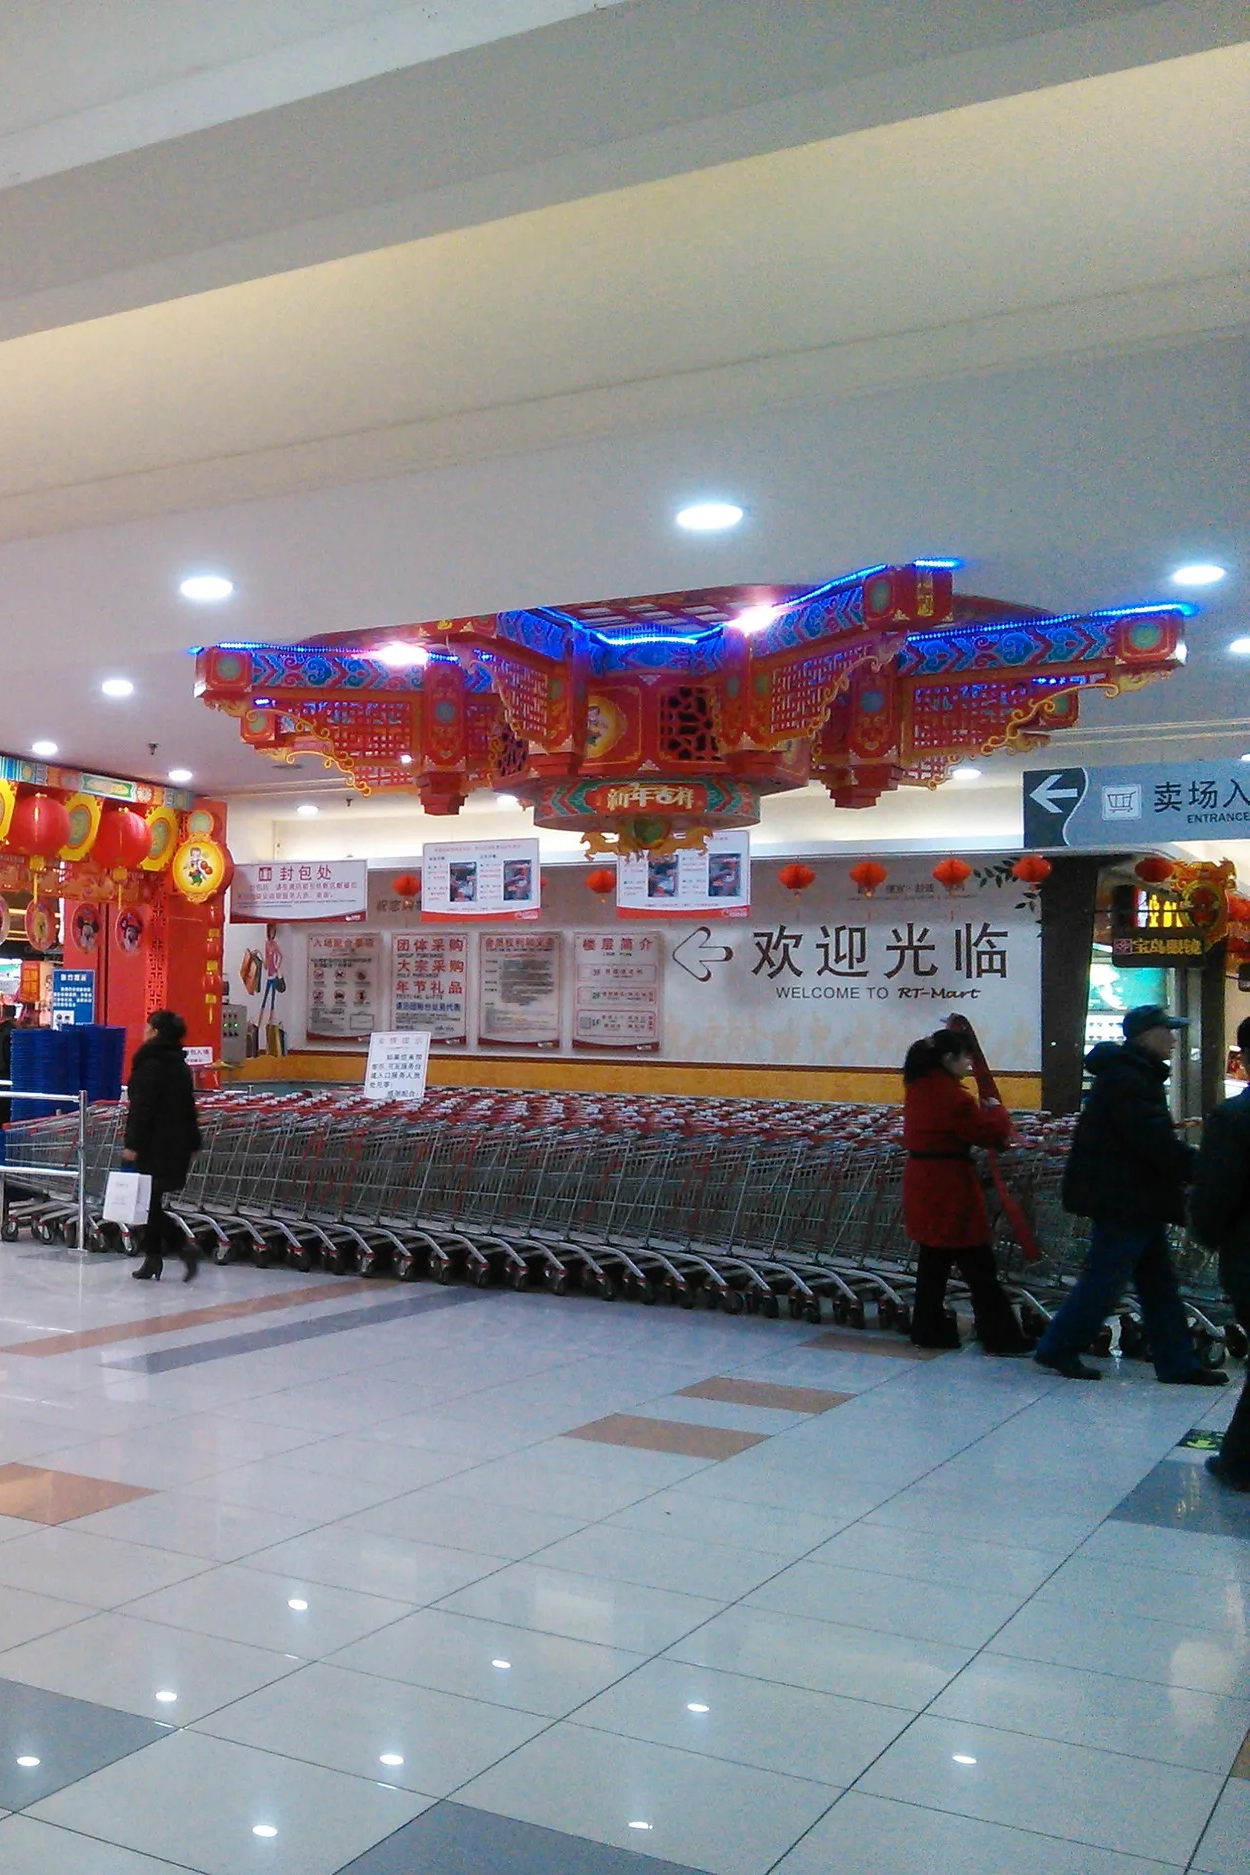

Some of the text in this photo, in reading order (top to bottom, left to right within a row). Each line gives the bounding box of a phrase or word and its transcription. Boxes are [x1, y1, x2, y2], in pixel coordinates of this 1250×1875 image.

[1154, 779, 1250, 812] 卖场入
[1187, 812, 1250, 823] ENTRANCE
[280, 865, 332, 881] 封包处
[397, 938, 463, 952] 团体采购
[583, 938, 652, 951] 楼层简介
[751, 922, 1009, 980] 欢迎光临
[398, 960, 464, 972] 大宗采购
[396, 980, 462, 994] 年节礼品
[776, 986, 981, 999] WELCOME TO RT-Mart
